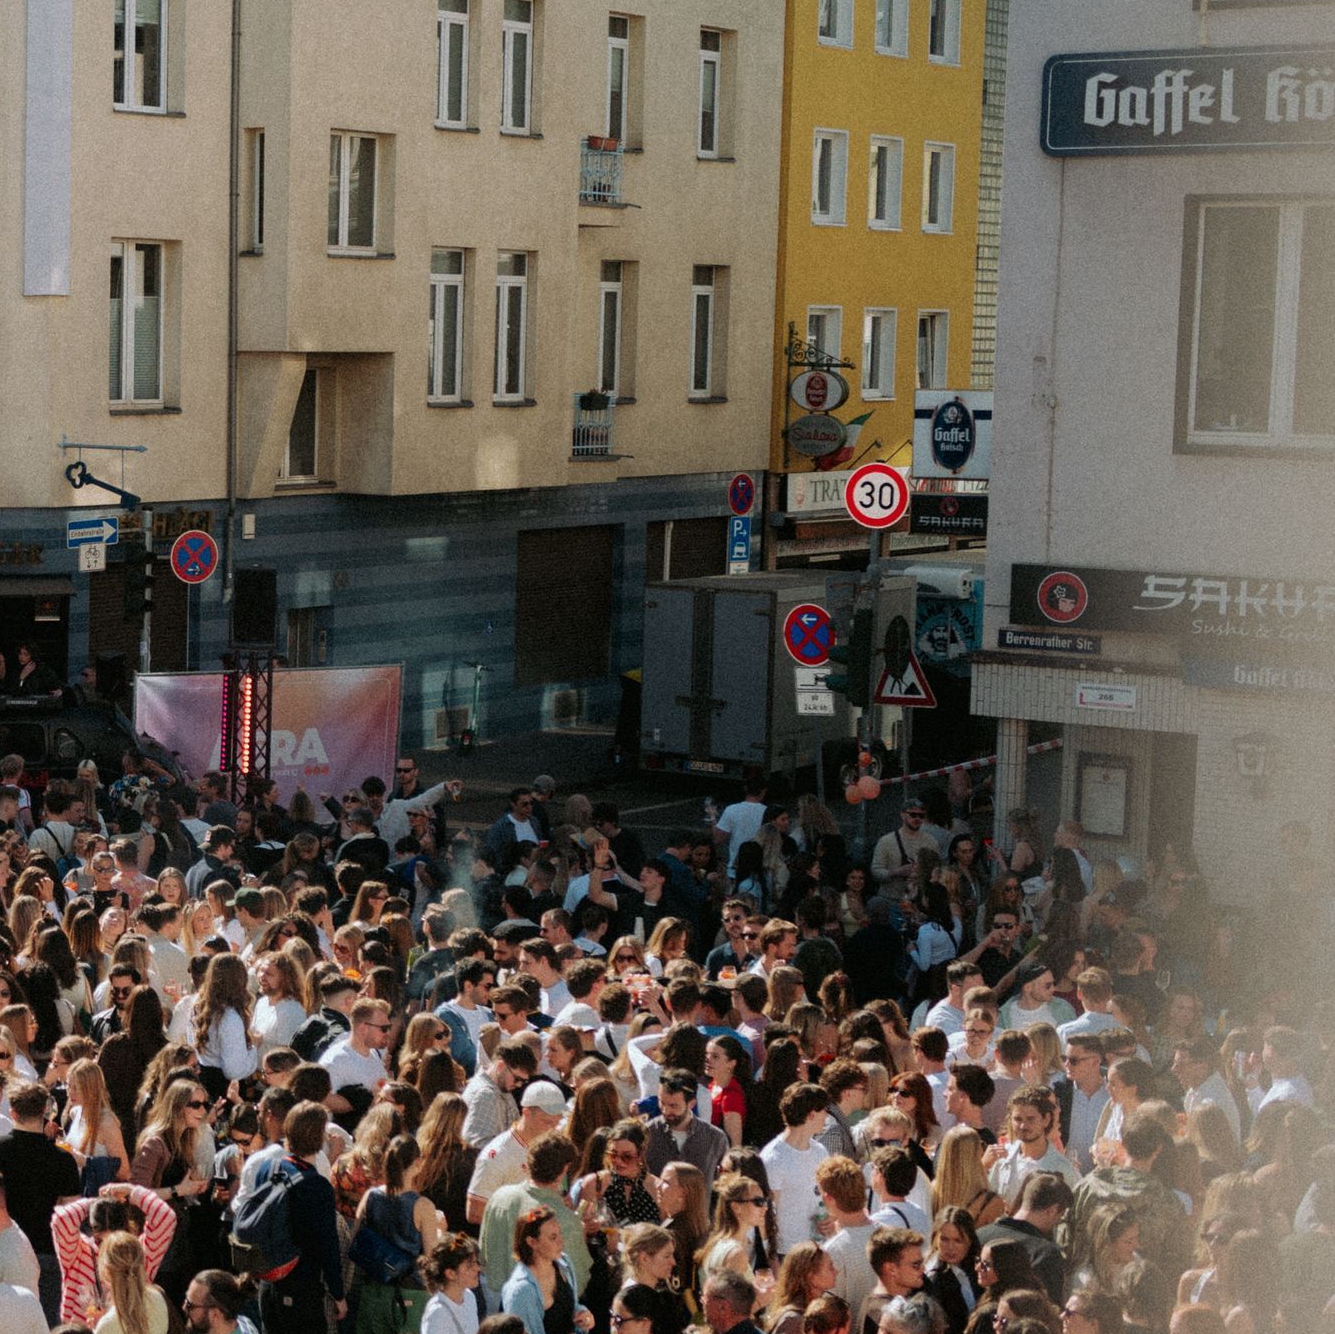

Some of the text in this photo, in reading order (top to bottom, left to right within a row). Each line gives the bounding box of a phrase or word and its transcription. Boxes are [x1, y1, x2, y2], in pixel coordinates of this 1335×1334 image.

[1083, 67, 1241, 137] Gaffel
[933, 426, 971, 444] Gaffel
[859, 481, 894, 510] 30
[919, 515, 985, 528] SAKURA
[1192, 619, 1248, 637] Sushi
[1005, 631, 1094, 651] Berrenrather Str.
